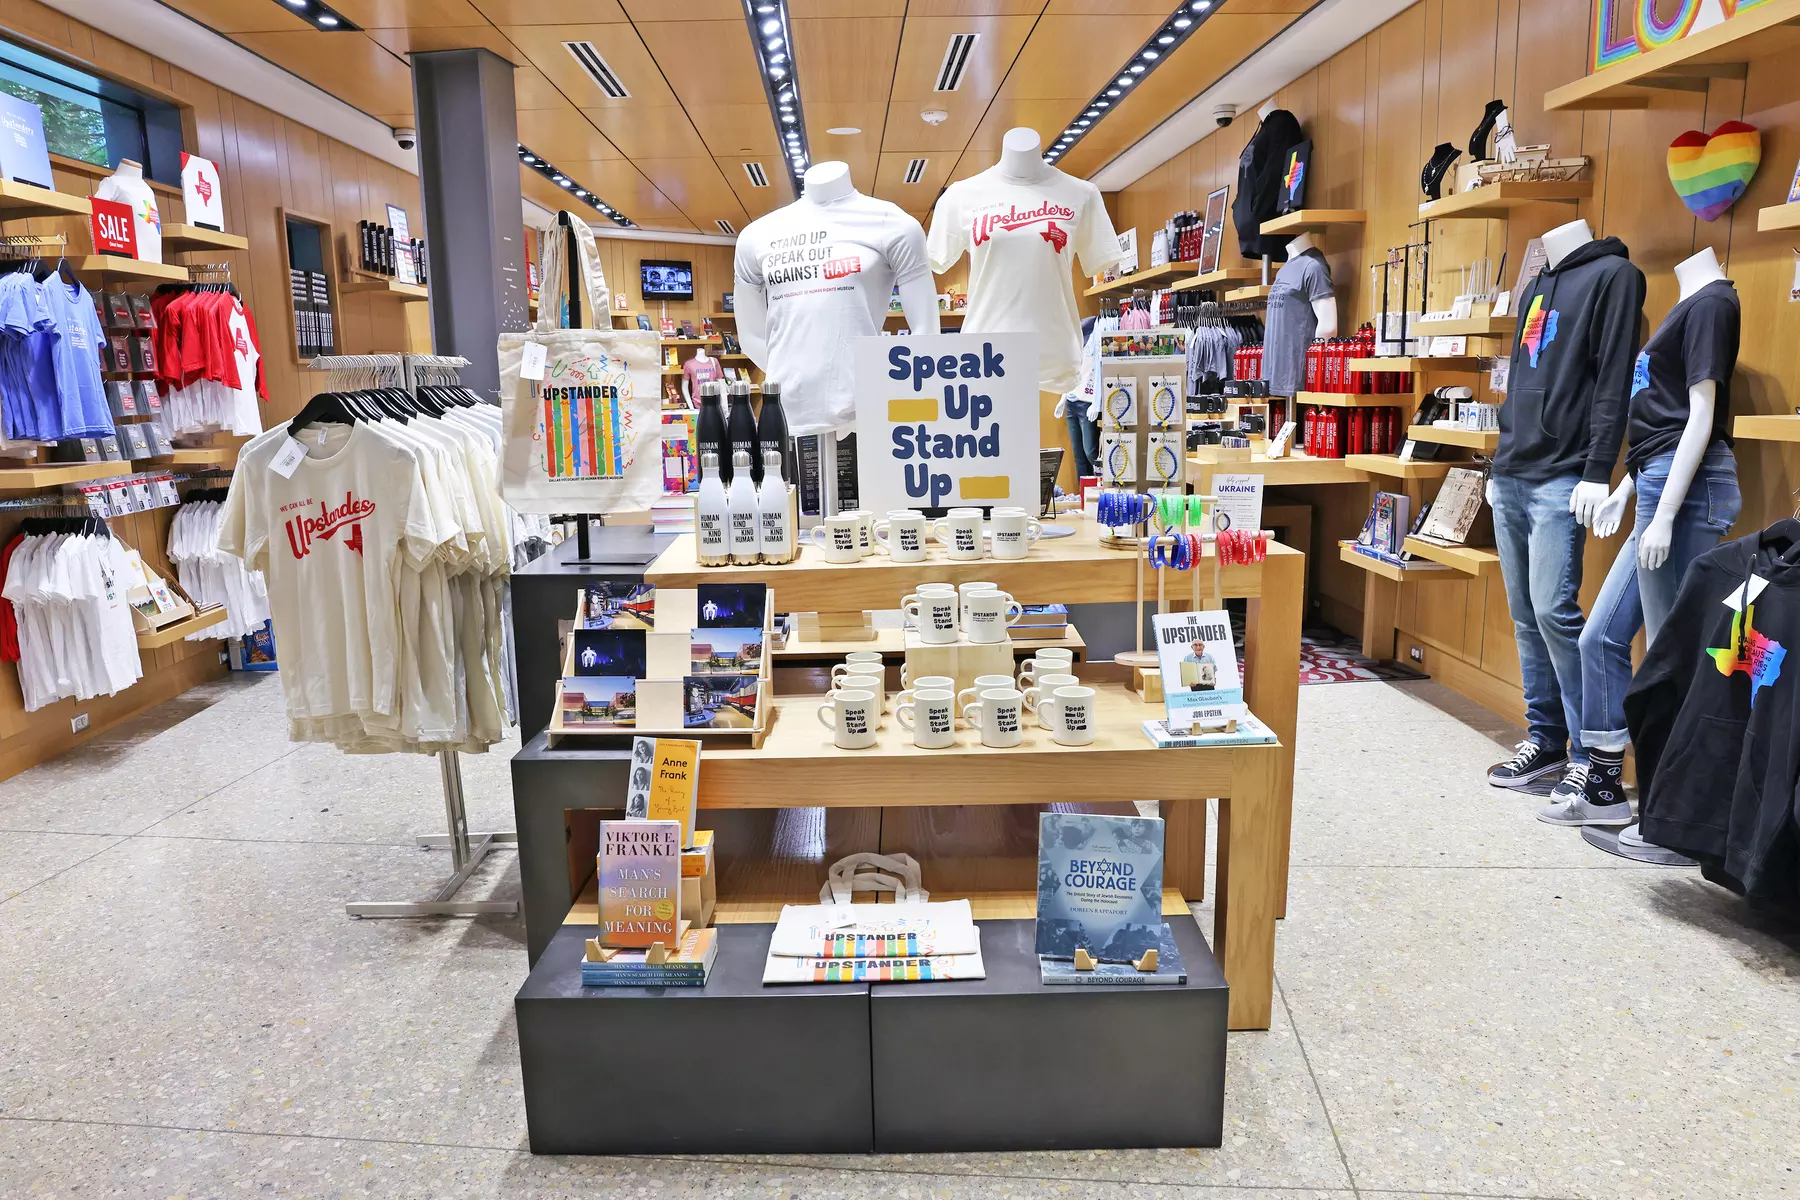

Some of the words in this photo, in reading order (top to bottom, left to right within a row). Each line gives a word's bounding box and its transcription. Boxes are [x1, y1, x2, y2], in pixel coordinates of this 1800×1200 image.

[98, 213, 130, 242] SALE
[972, 200, 1075, 246] Upstanders
[770, 234, 807, 250] STAND
[810, 231, 827, 244] UP
[768, 249, 805, 268] SPEAK
[808, 246, 833, 261] OUT
[768, 264, 820, 286] AGAINST
[824, 259, 859, 278] HATE
[888, 342, 1005, 392] Speak
[544, 386, 618, 400] UPSTANDER
[944, 384, 992, 430] Up
[892, 422, 1000, 460] Stand
[904, 462, 952, 508] Up
[932, 605, 952, 613] Speak
[1187, 616, 1197, 625] THE
[1162, 624, 1227, 644] UPSTANDER
[1192, 710, 1203, 718] JORI
[662, 758, 688, 768] Anne
[660, 770, 687, 780] Frank
[606, 832, 659, 842] VIKTOR
[665, 832, 675, 842] E.
[606, 844, 674, 856] FRANKL
[618, 868, 661, 880] MAN'S
[1065, 874, 1137, 891] COURAGE
[610, 887, 668, 898] SEARCH
[625, 905, 652, 917] FOR
[604, 921, 673, 933] MEANING
[825, 932, 917, 942] UPSTANDER
[815, 960, 931, 970] UPSTANDER
